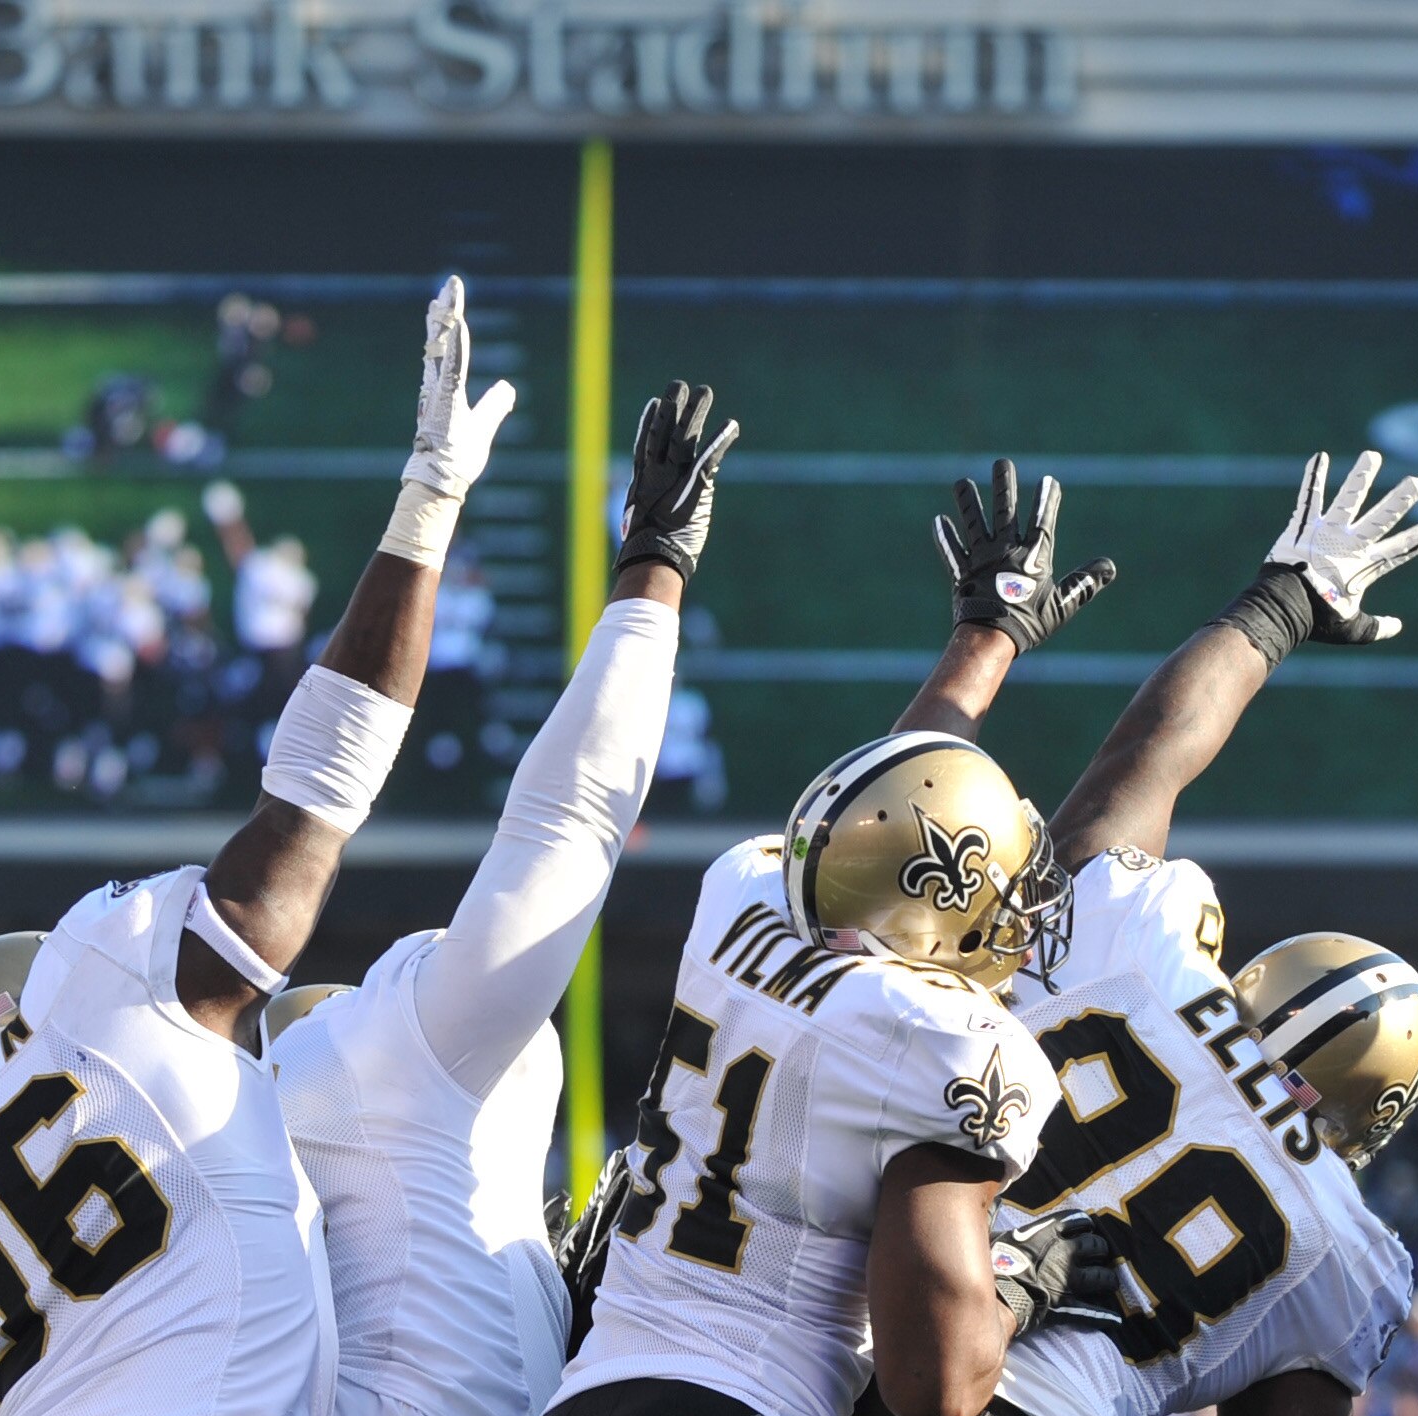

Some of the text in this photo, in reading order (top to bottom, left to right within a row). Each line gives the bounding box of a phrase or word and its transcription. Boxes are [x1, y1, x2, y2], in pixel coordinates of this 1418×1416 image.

[414, 0, 1078, 112] Stadium
[710, 901, 849, 1016] VILMA
[617, 998, 776, 1275] 51
[1177, 987, 1322, 1165] ELLIS
